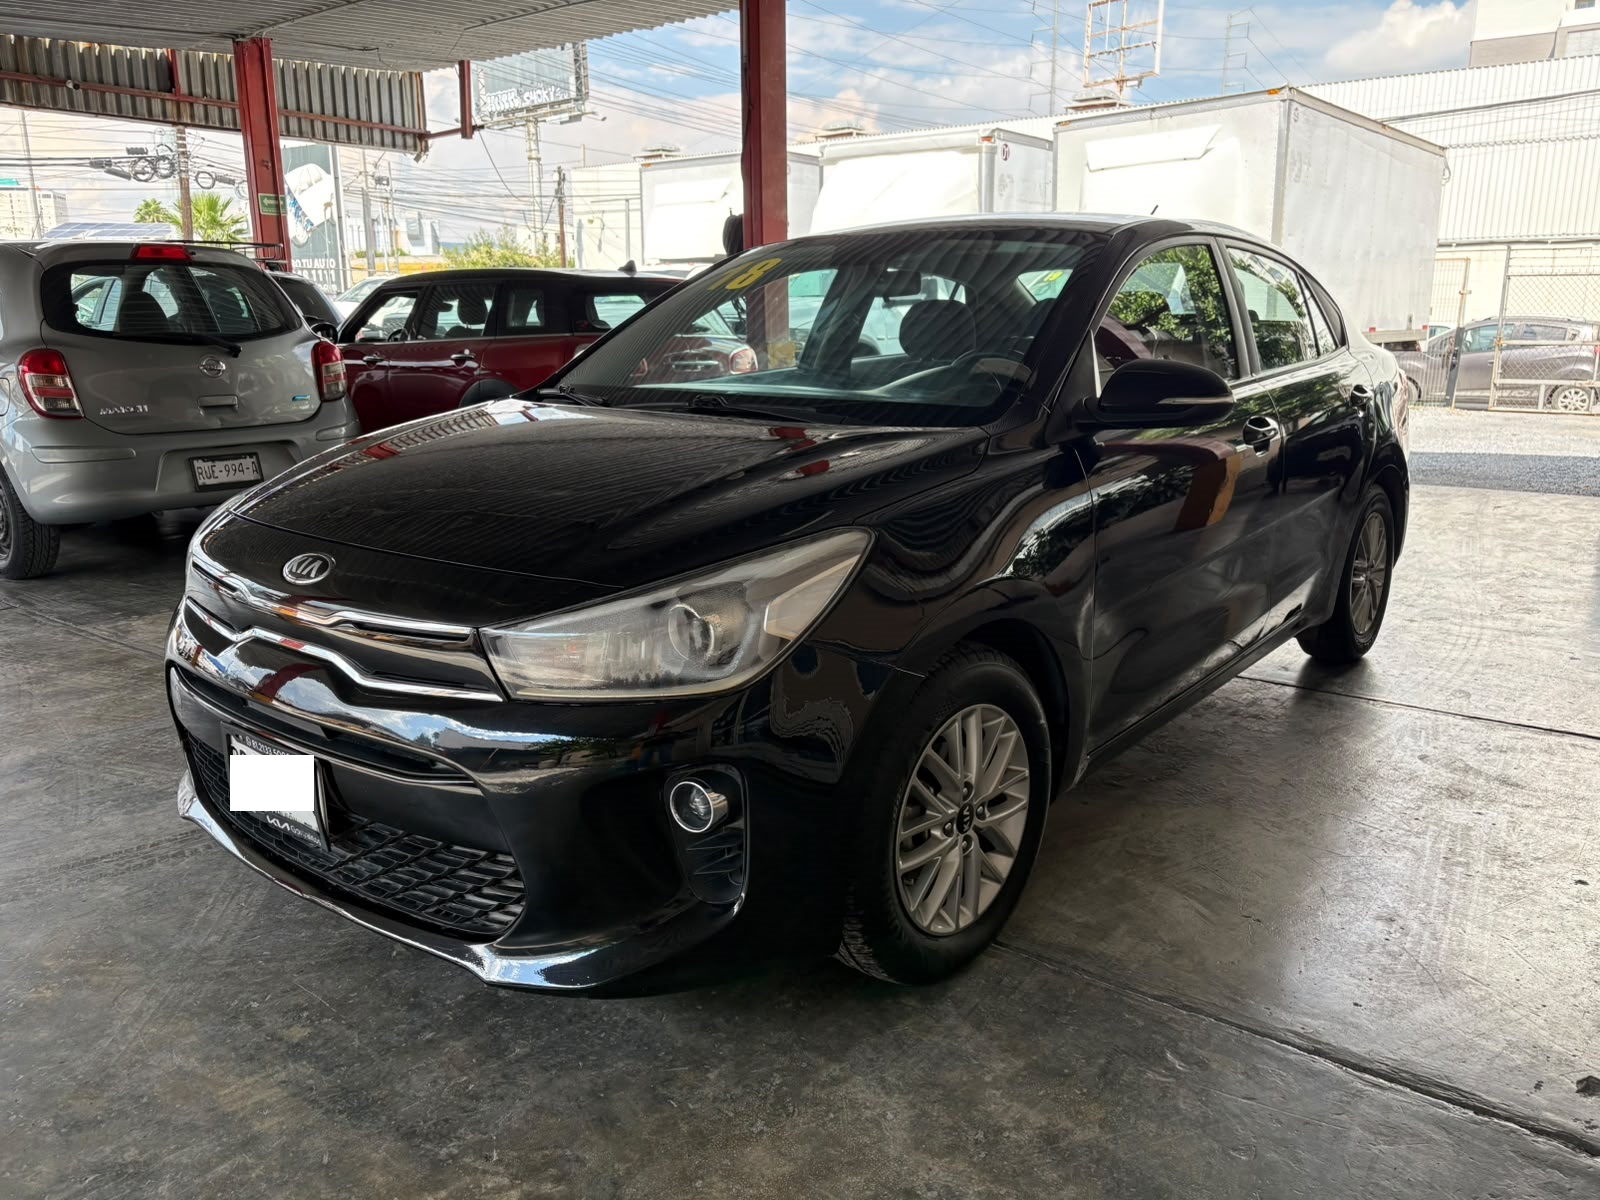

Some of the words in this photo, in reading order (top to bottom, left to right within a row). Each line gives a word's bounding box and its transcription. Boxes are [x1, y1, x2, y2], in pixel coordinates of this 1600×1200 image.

[706, 258, 782, 290] 18
[197, 461, 259, 480] RUE-994-A
[287, 557, 323, 578] KIA
[963, 806, 971, 832] KIA
